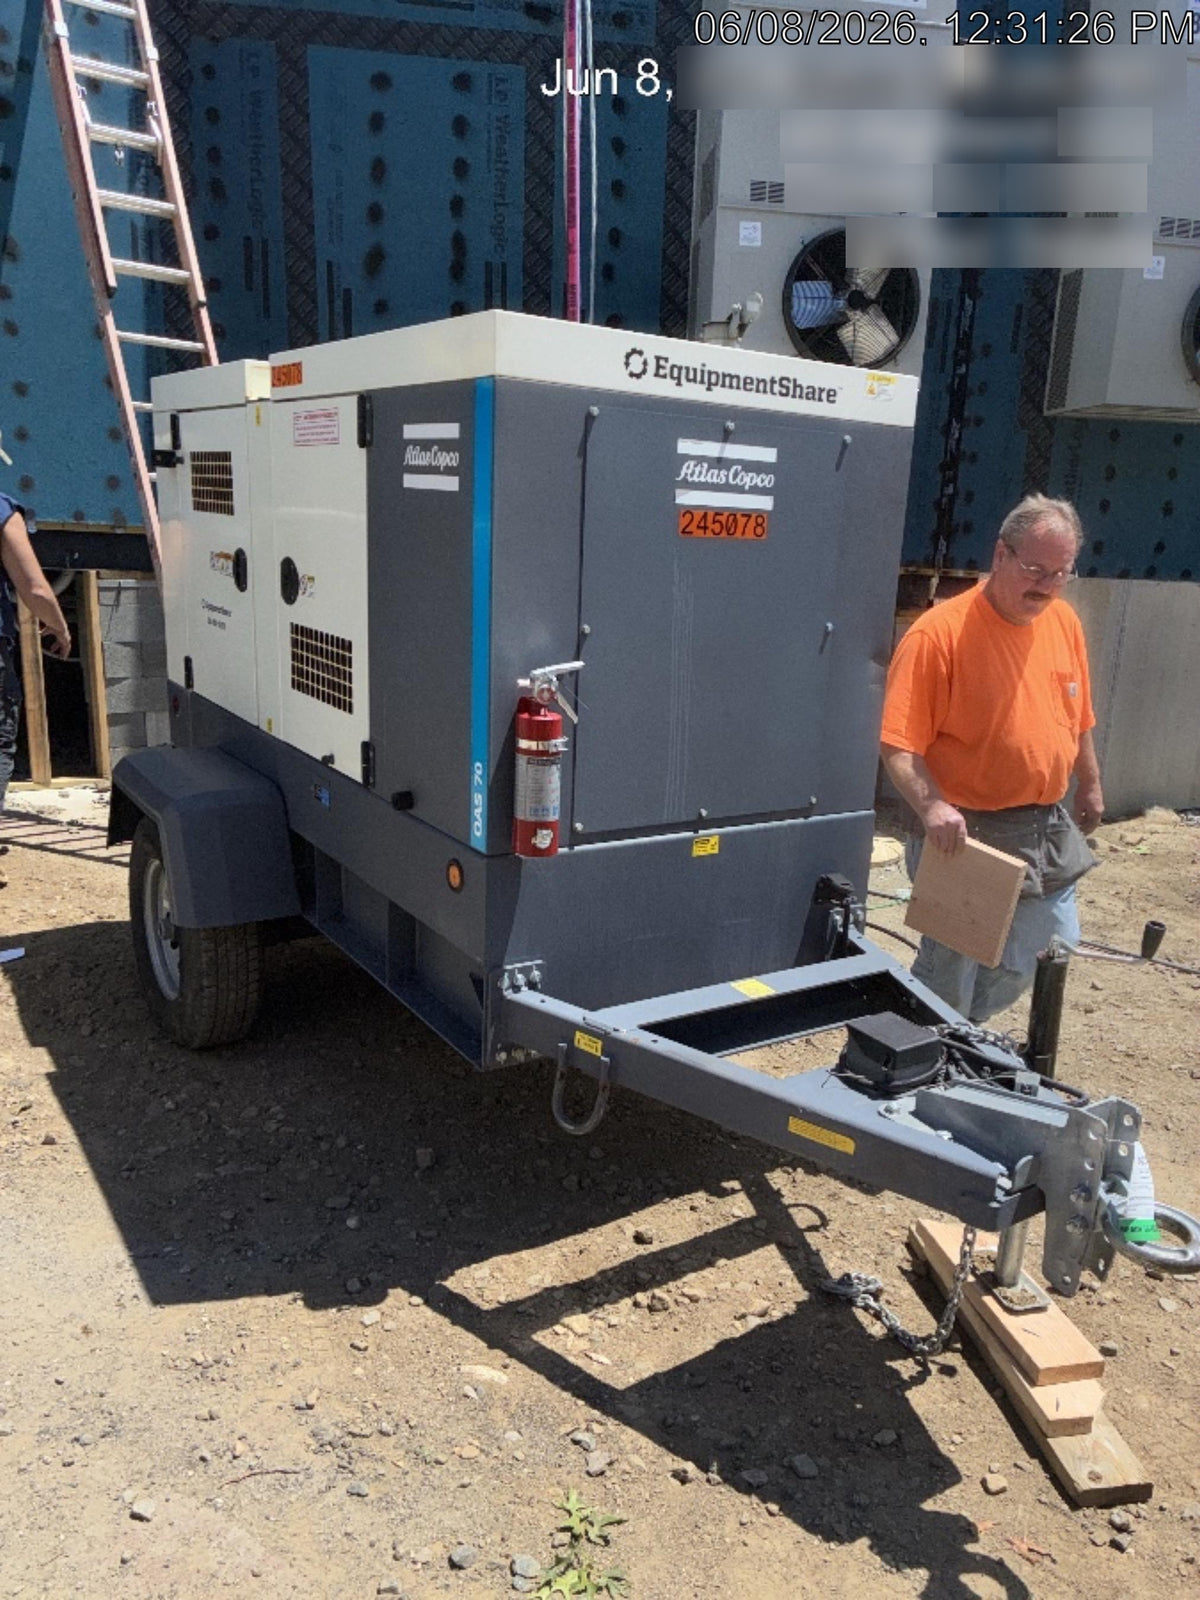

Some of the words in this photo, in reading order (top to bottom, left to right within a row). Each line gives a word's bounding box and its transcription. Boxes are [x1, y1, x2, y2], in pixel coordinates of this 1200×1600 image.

[492, 115, 514, 255] WeatherLogic
[654, 356, 838, 403] EquipmentShare
[403, 445, 430, 466] Atlas
[431, 445, 460, 472] Copco
[676, 460, 728, 485] Atlas
[728, 465, 775, 490] Copco
[680, 511, 766, 538] 245078
[473, 761, 483, 786] 70
